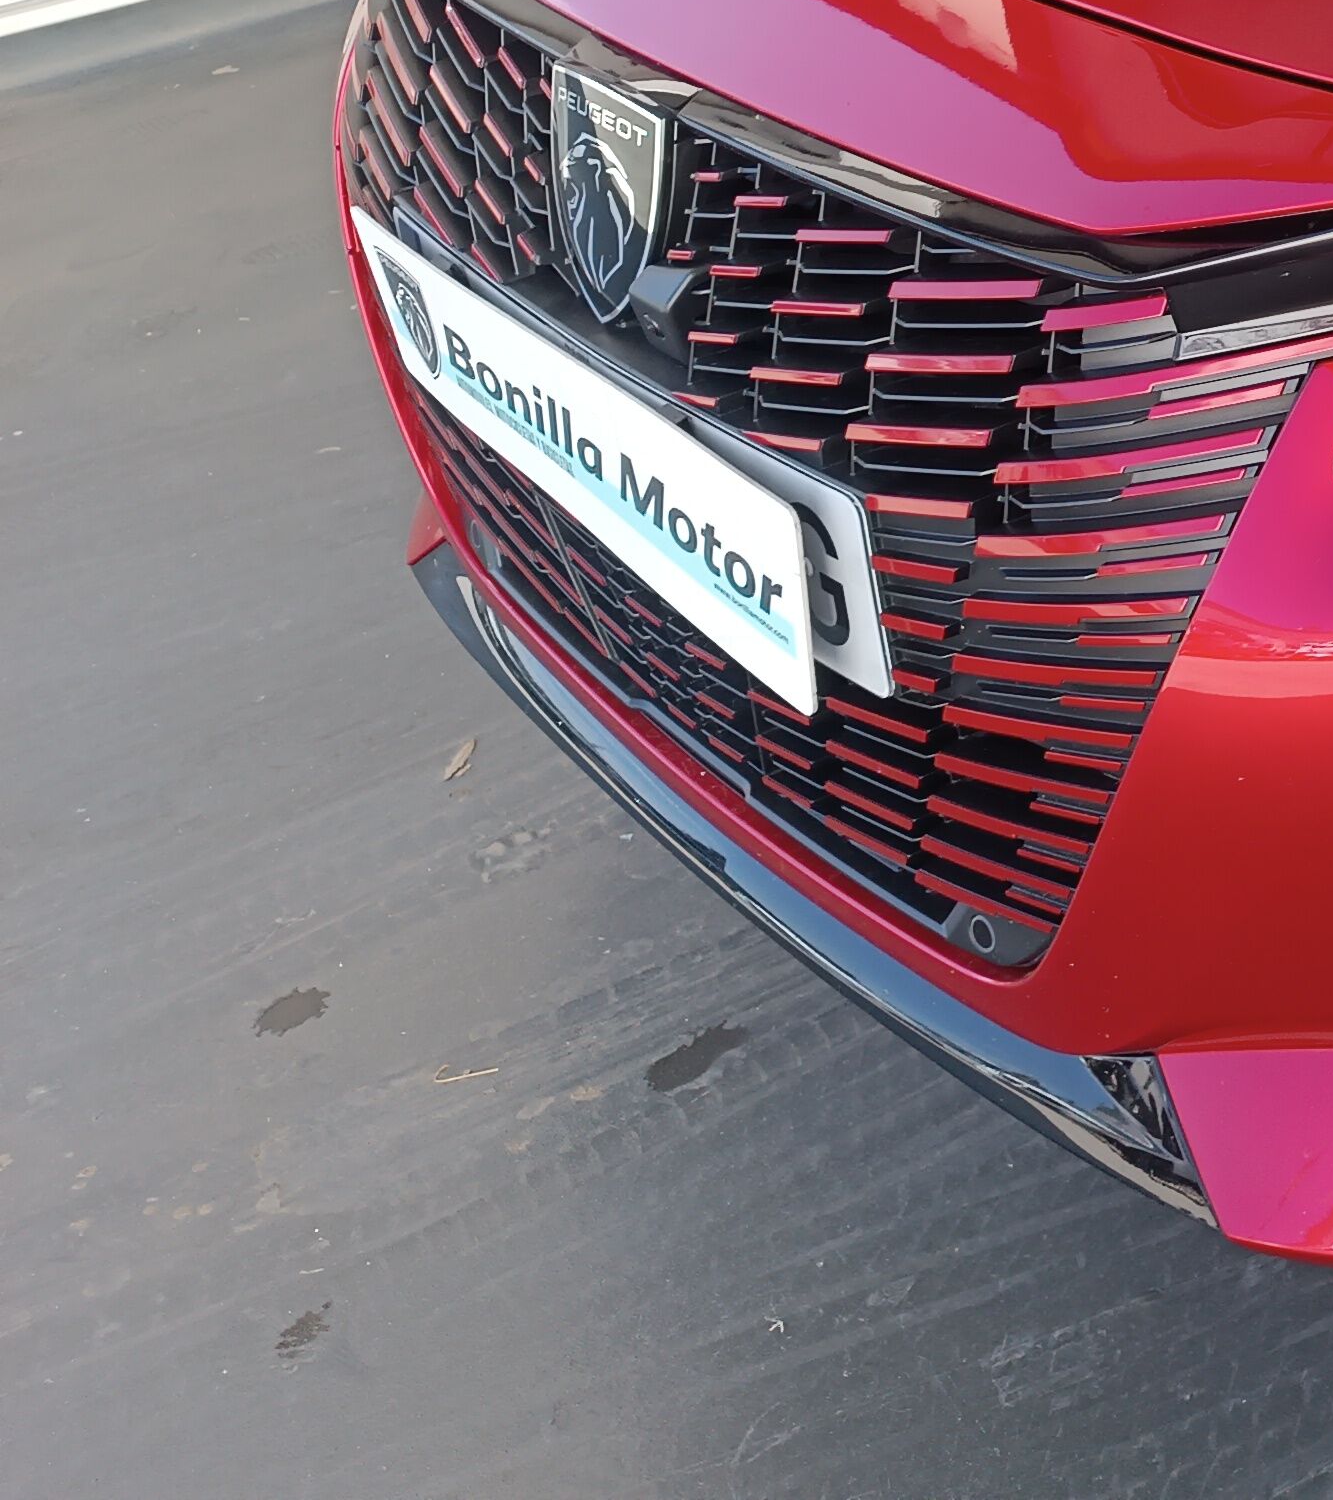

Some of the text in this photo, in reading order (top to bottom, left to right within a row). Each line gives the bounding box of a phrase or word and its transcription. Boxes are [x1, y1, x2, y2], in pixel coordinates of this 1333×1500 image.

[557, 86, 648, 147] PEUGEOT
[443, 324, 604, 482] Bonilla
[620, 451, 784, 616] Motor
